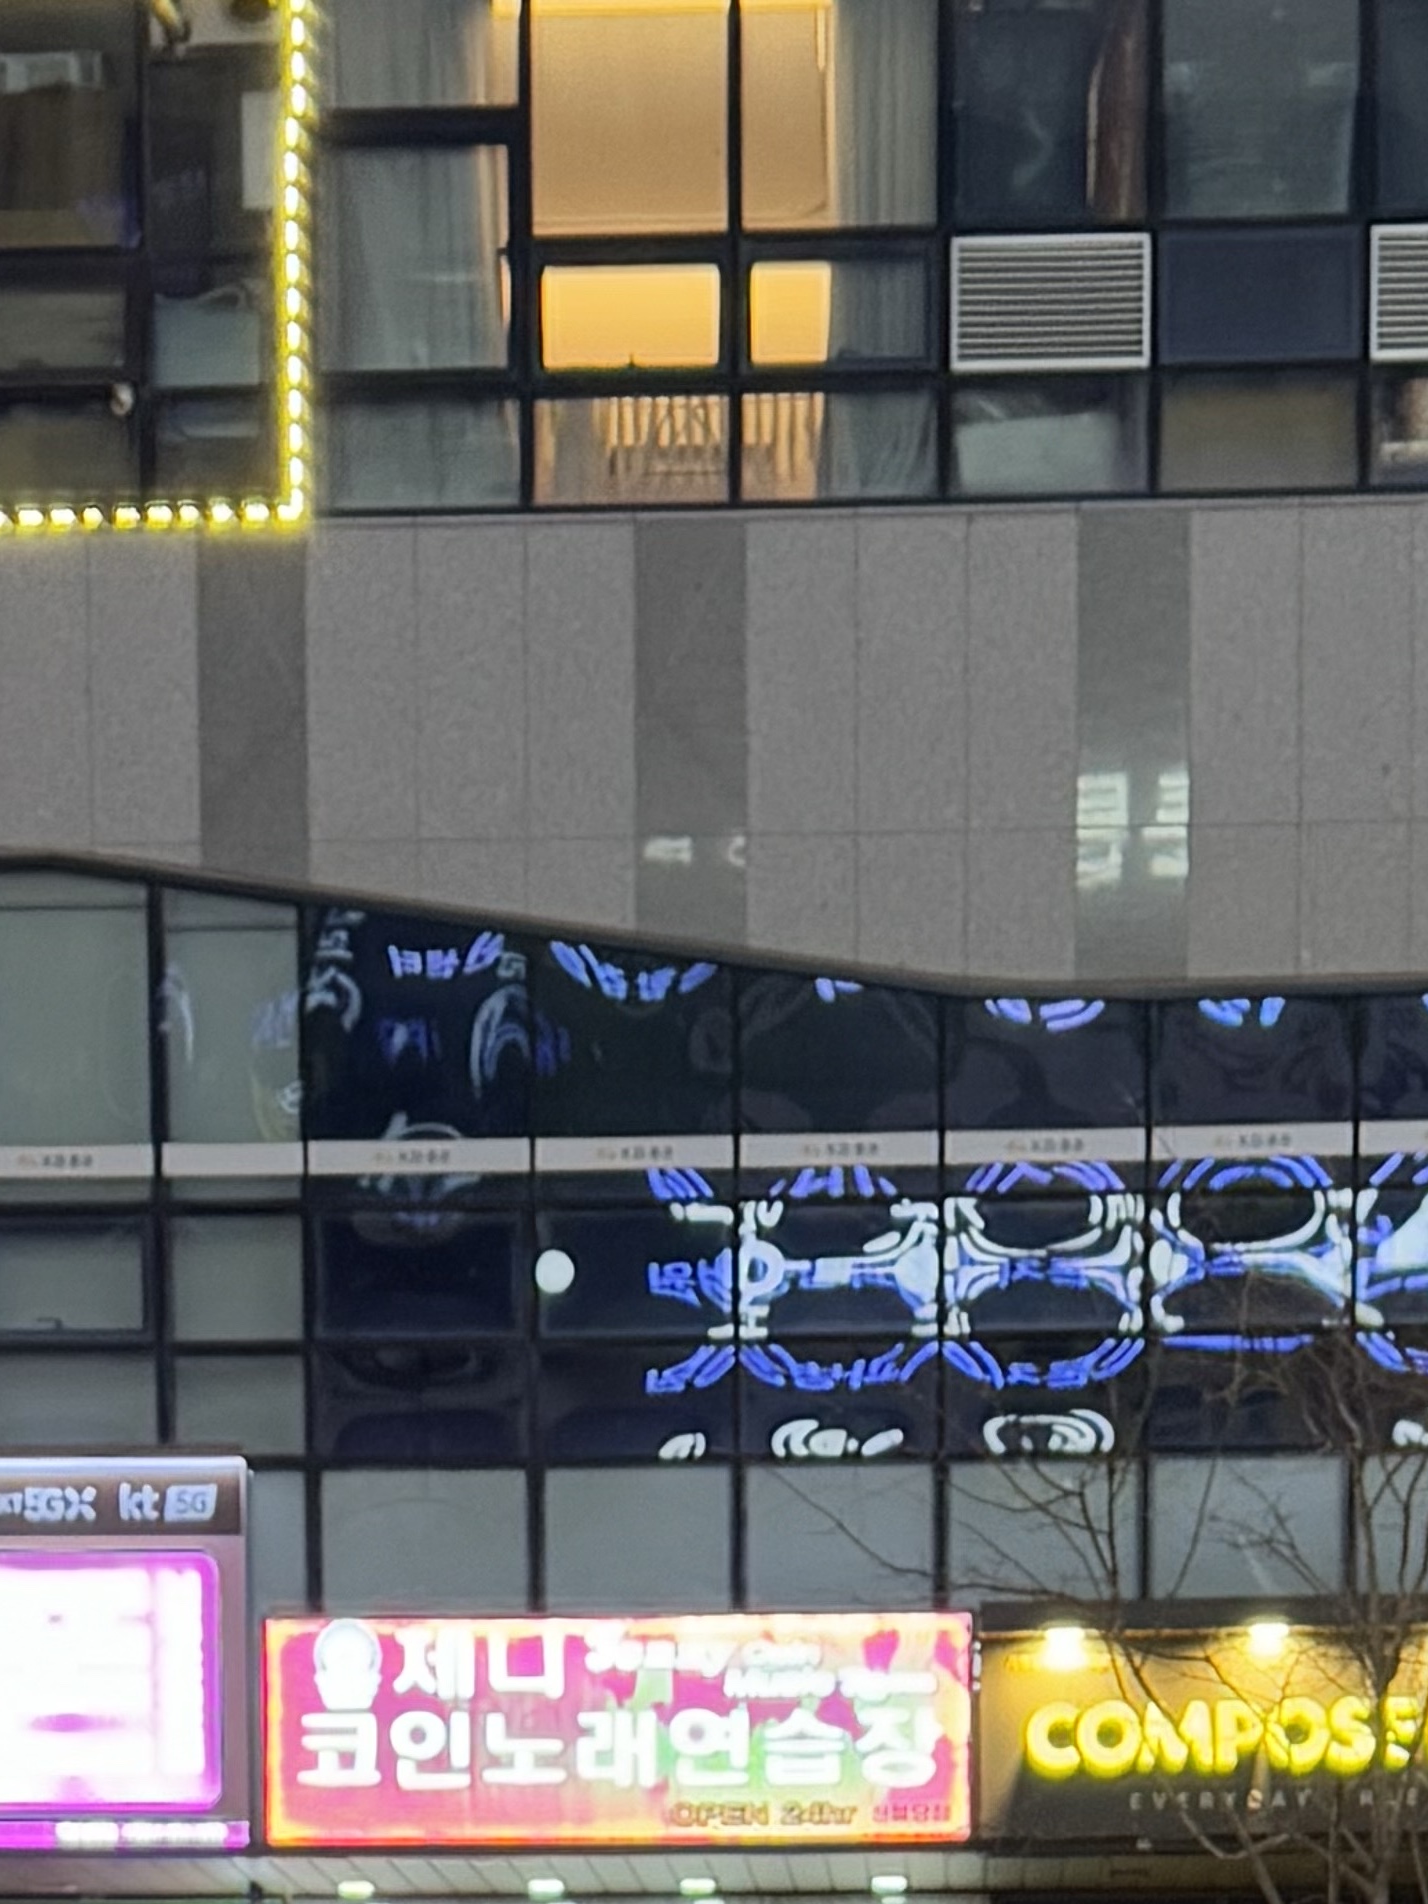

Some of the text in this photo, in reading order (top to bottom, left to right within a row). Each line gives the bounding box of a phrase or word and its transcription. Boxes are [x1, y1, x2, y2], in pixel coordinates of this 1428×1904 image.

[118, 1482, 160, 1521] kt
[296, 1709, 945, 1789] 코인노래연습장
[1025, 1695, 1420, 1777] COMPOSE
[670, 1801, 770, 1827] OPEN
